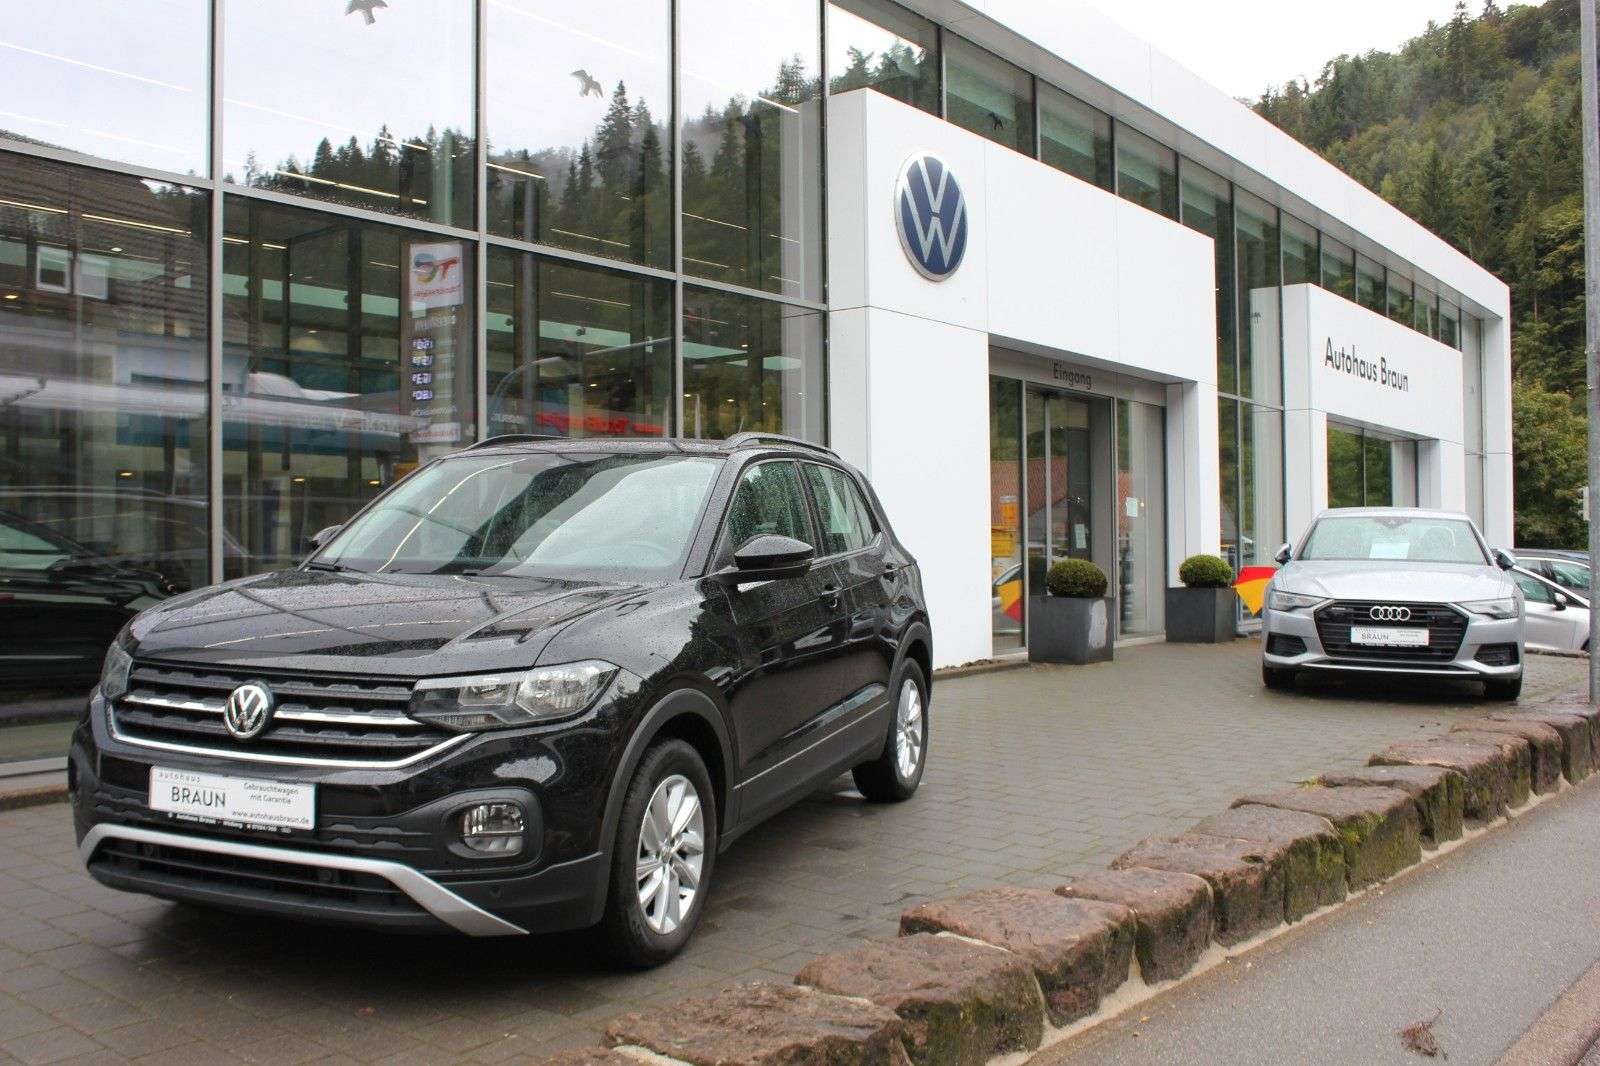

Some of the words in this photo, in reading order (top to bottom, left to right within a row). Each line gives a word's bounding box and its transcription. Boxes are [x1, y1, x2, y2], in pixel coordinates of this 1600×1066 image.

[1325, 336, 1378, 382] Autohaus
[1380, 356, 1409, 392] Braun
[1053, 362, 1092, 390] Eingang
[1361, 632, 1390, 641] BRAUN
[159, 771, 201, 783] autohaus
[243, 782, 299, 796] Gebrauchtwagen
[171, 786, 226, 808] BRAUN
[250, 793, 263, 802] mit
[263, 794, 292, 805] Garantie
[232, 810, 310, 825] www.autohausbraun.de
